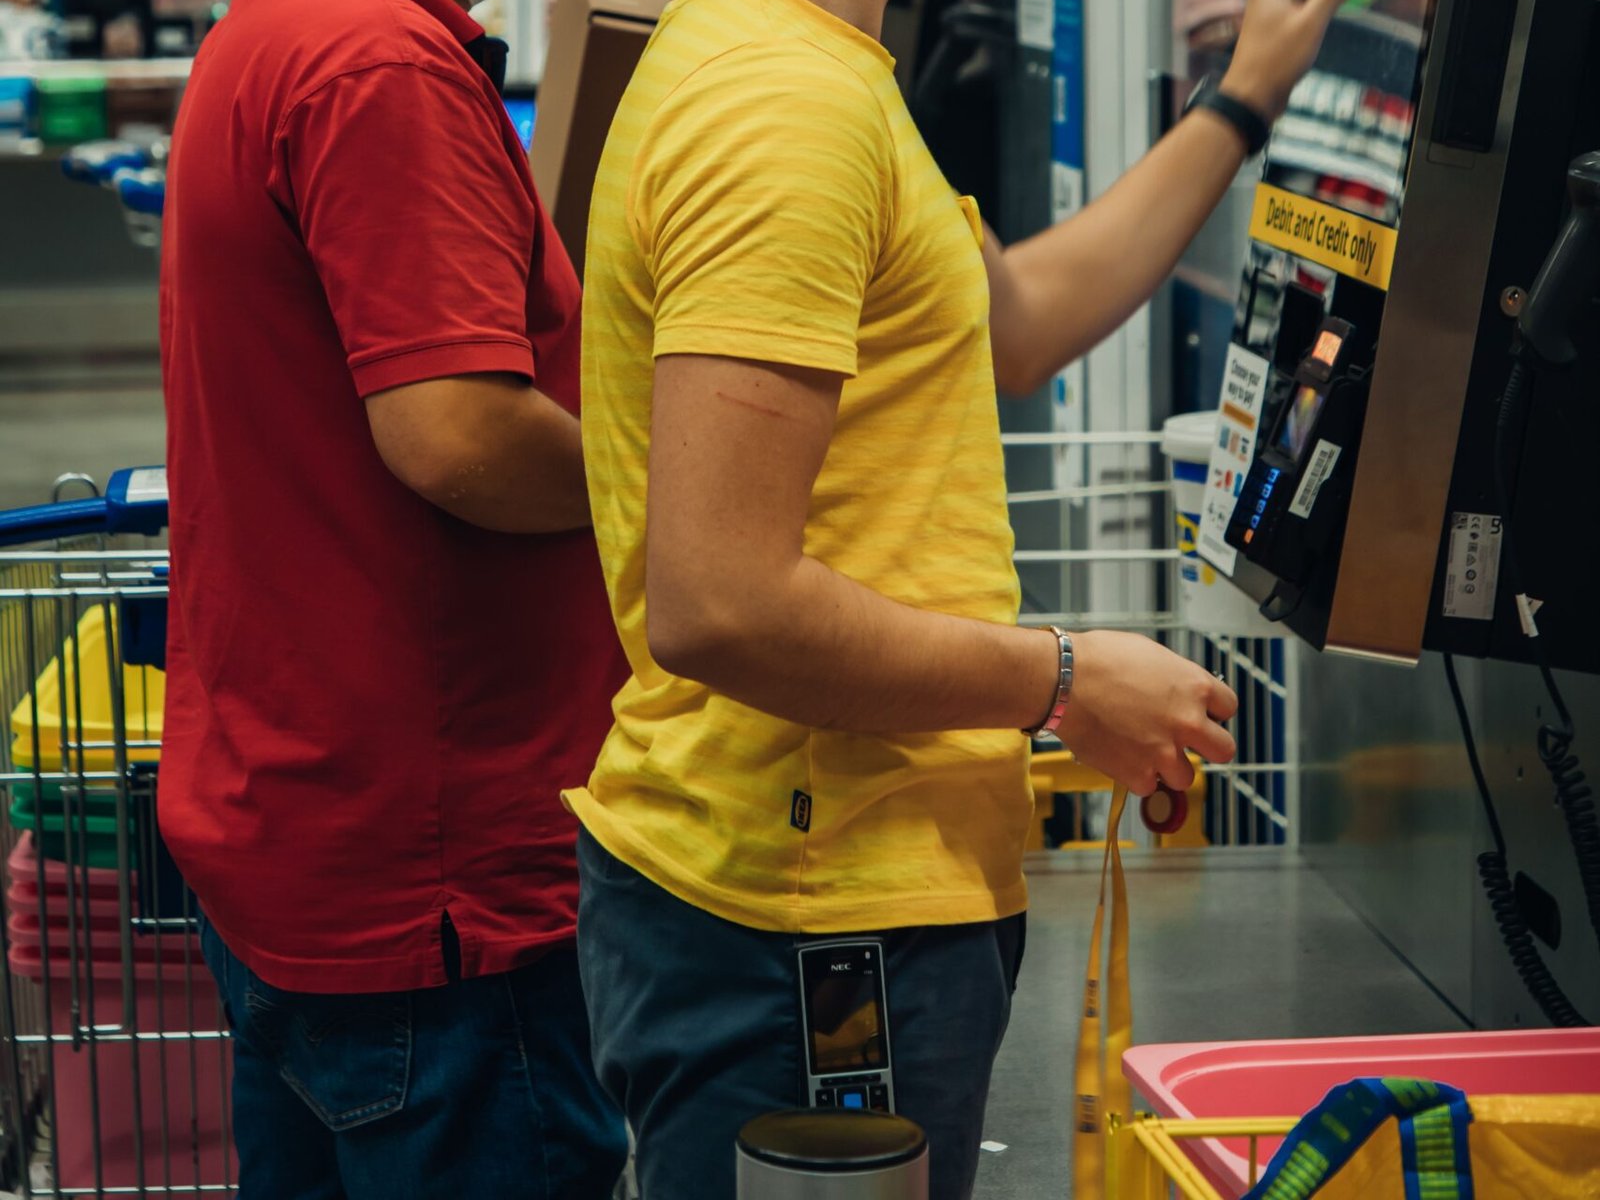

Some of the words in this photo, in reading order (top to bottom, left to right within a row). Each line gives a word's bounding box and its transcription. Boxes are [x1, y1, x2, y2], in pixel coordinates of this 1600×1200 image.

[1266, 197, 1294, 234] Debit
[1294, 210, 1317, 243] and
[1316, 215, 1350, 257] Credit
[1350, 230, 1377, 276] only
[831, 963, 852, 972] NEC
